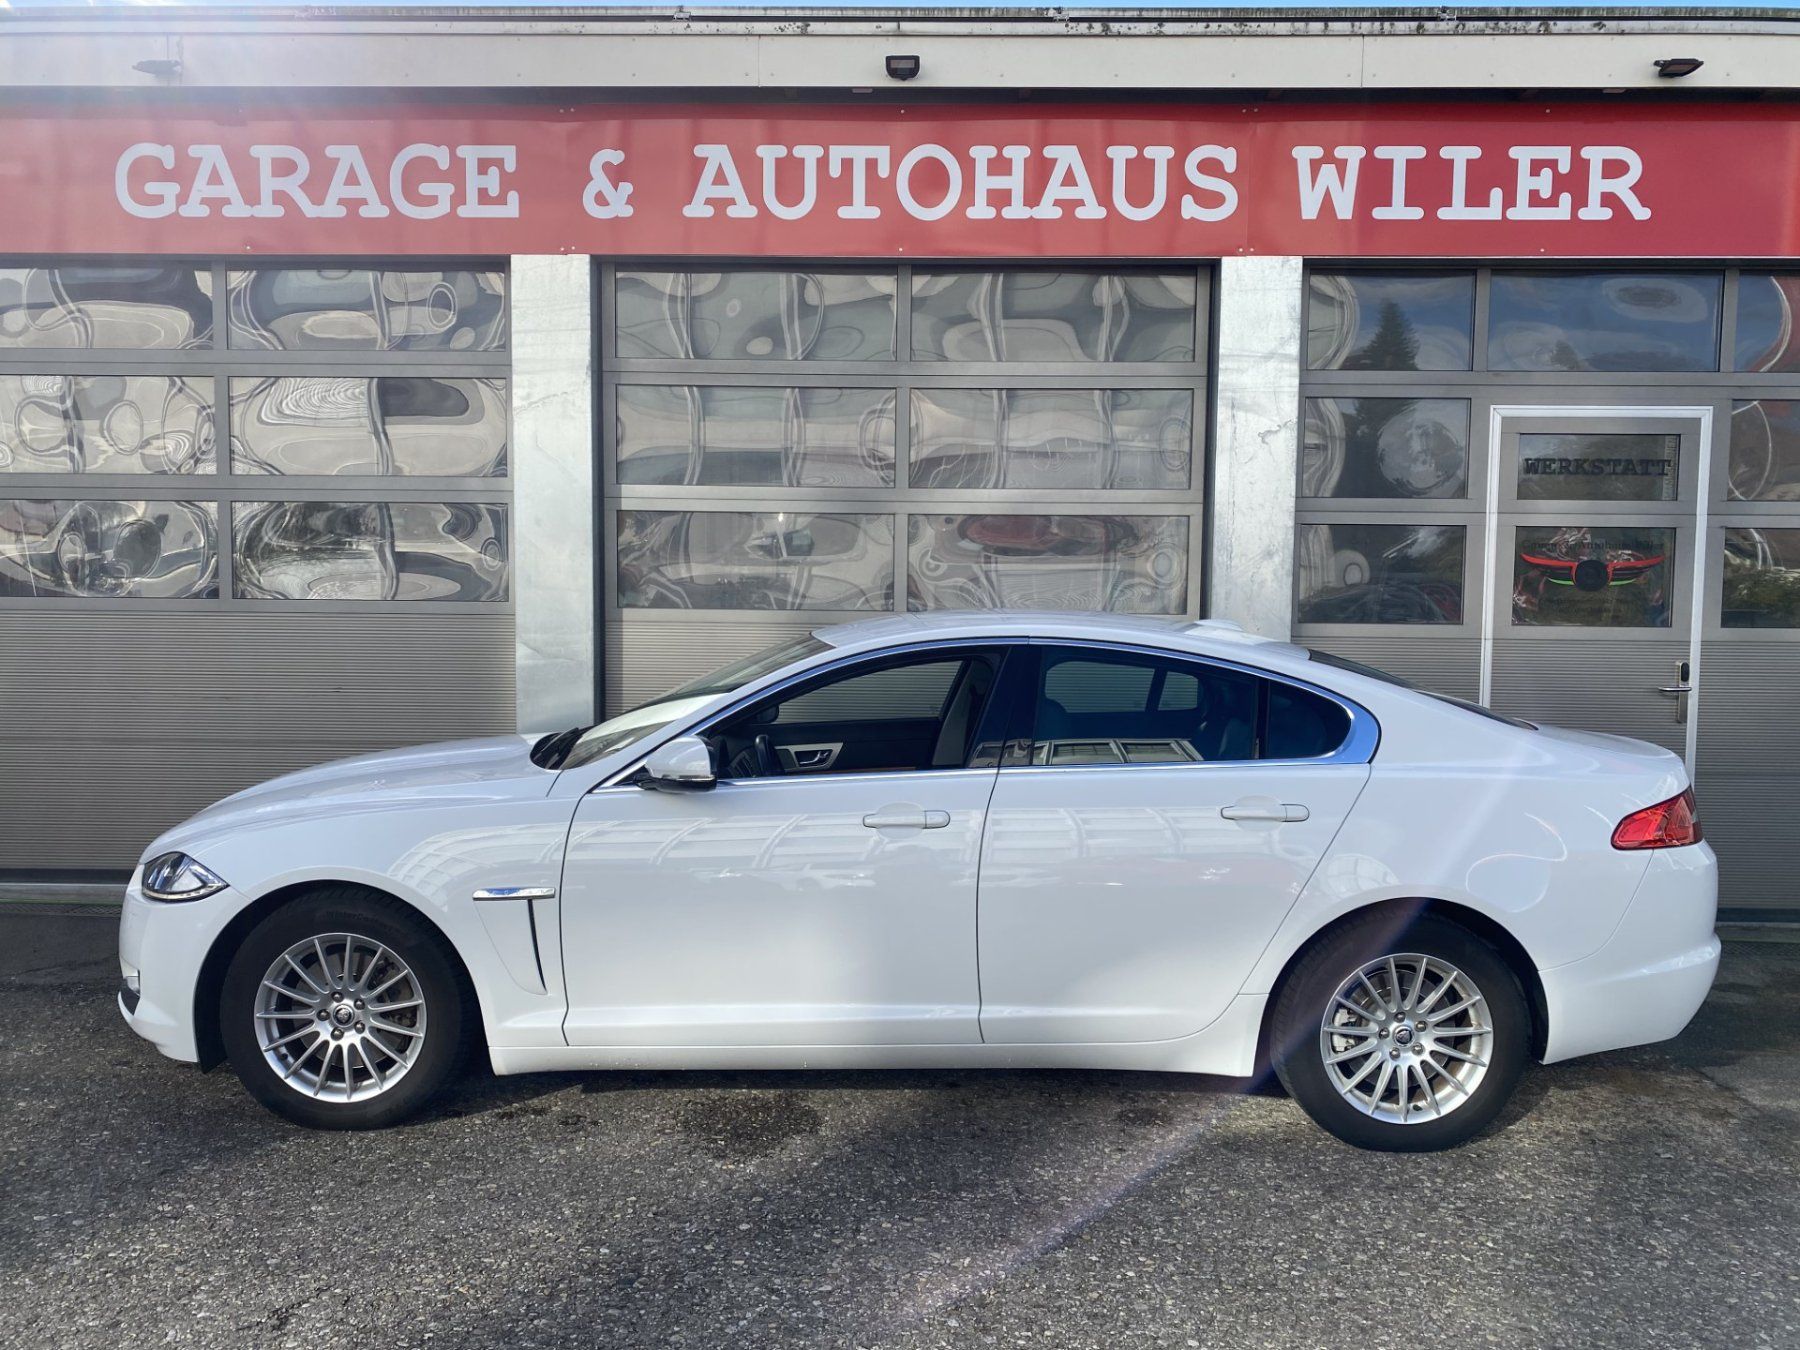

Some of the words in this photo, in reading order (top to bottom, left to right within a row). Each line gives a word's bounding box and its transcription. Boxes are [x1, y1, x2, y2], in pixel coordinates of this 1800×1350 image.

[114, 143, 520, 219] GARAGE
[582, 148, 634, 219] &
[683, 144, 1239, 221] AUTOHAUS
[1291, 145, 1652, 221] WILER
[1524, 458, 1671, 476] WERKSTATT
